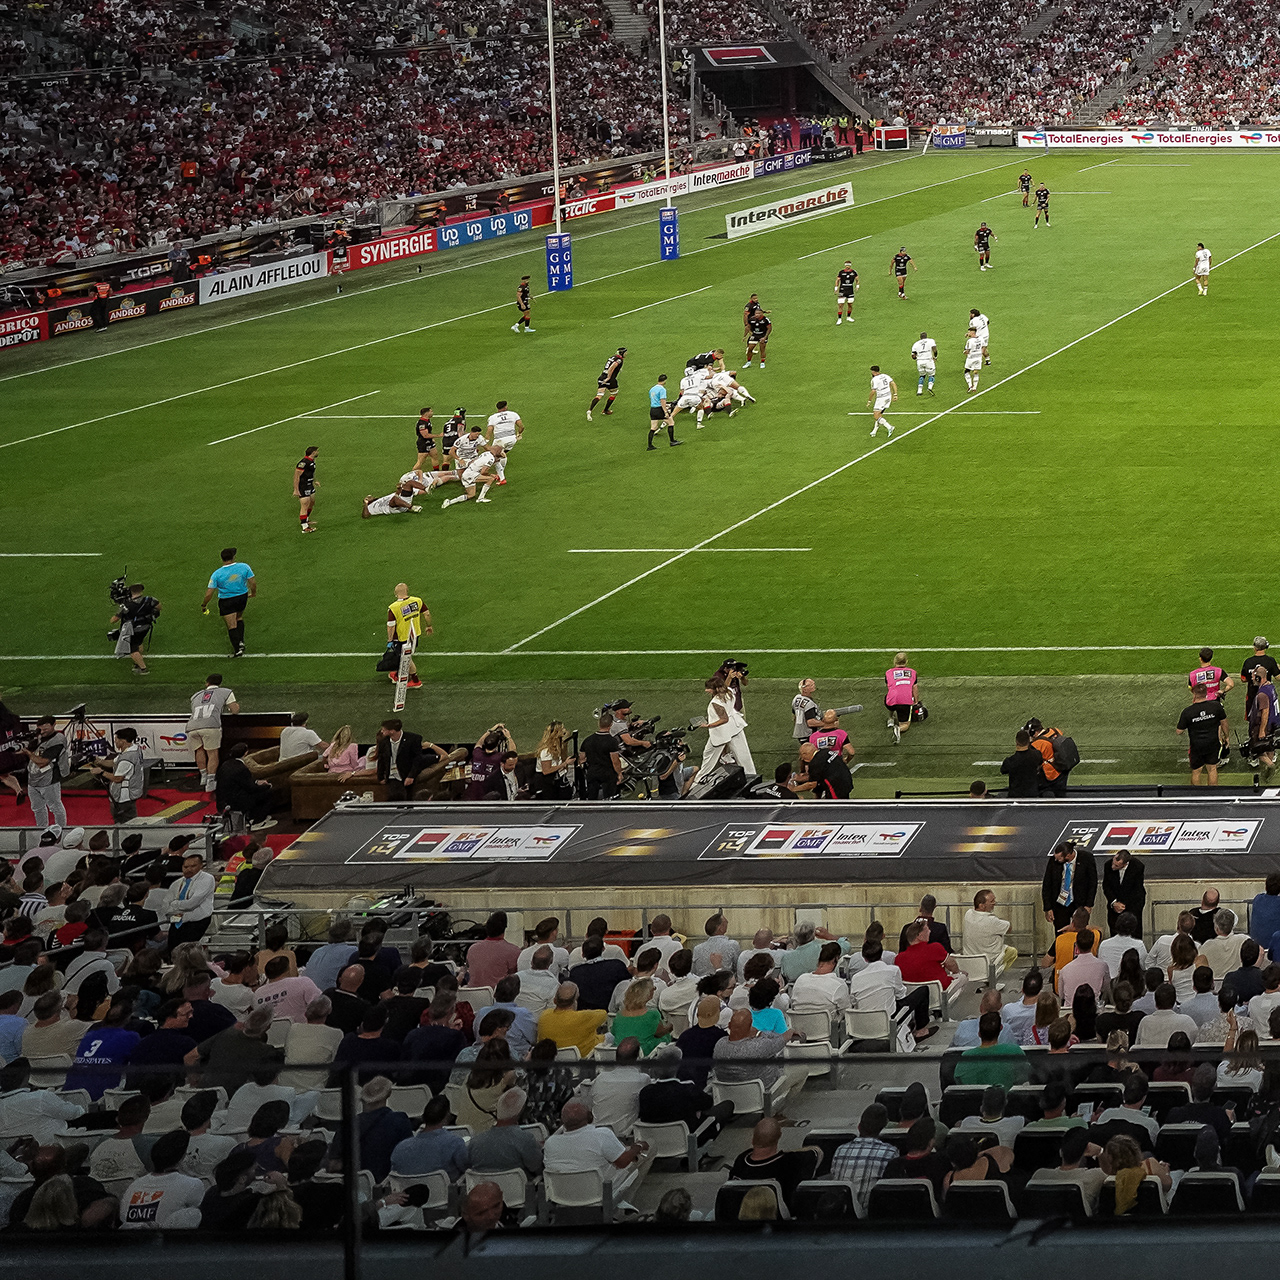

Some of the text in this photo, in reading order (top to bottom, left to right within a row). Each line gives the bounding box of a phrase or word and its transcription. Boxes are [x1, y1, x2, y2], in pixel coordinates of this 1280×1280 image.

[943, 136, 964, 145] GMF
[1049, 134, 1124, 144] TotalEnergies
[1158, 134, 1232, 145] TotalEnergies
[766, 158, 783, 171] GMF
[795, 152, 812, 164] GMF
[664, 225, 675, 256] GMF
[361, 233, 433, 265] SYNERGIE
[127, 264, 162, 279] TOP
[550, 253, 560, 287] GMF
[563, 252, 571, 285] GMF
[209, 259, 320, 297] ALAIN AFFLELOU
[160, 295, 195, 309] ANDROS
[110, 306, 146, 320] ANDROS
[55, 316, 94, 333] ANDROS
[193, 704, 215, 720] TV
[837, 833, 867, 844] Inter
[1143, 836, 1168, 844] GMF
[1181, 829, 1210, 841] Inter
[449, 842, 473, 851] GMF
[489, 836, 521, 849] Inter
[798, 838, 824, 847] GMF
[84, 1040, 103, 1057] 3
[129, 1210, 155, 1220] GMF
